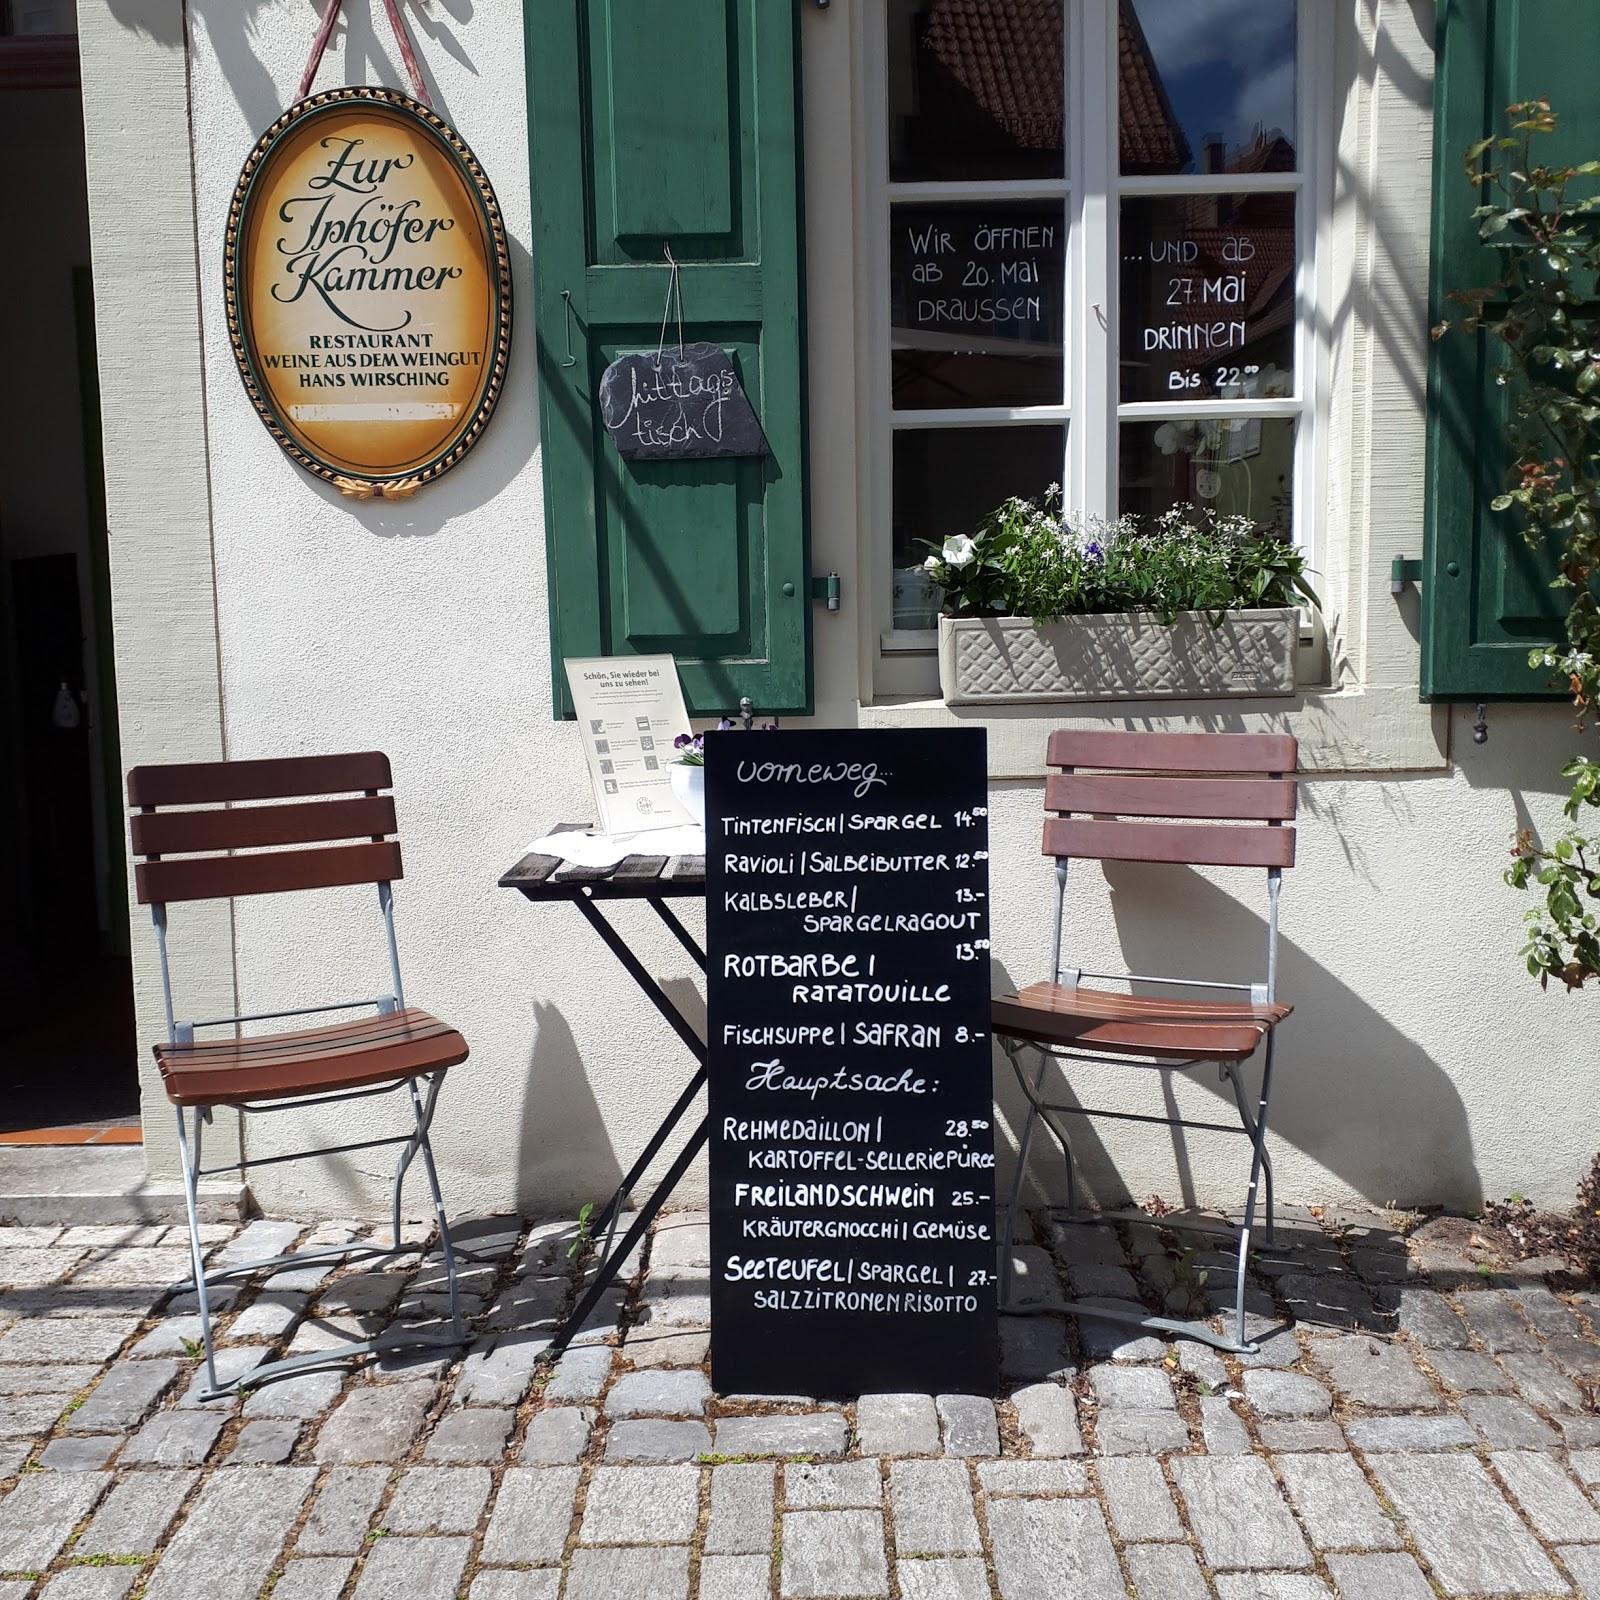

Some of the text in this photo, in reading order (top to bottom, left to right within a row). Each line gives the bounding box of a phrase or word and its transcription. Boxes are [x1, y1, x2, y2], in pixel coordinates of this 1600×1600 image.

[309, 136, 414, 193] Zur
[270, 246, 462, 331] Kammer
[310, 334, 433, 349] RESTAURANT
[264, 352, 481, 368] WEINE AUS DEM WEINGUT
[300, 372, 449, 387] HANS WIRSCHING
[584, 672, 609, 680] Schön,
[622, 670, 647, 678] wieder
[648, 669, 660, 677] bei
